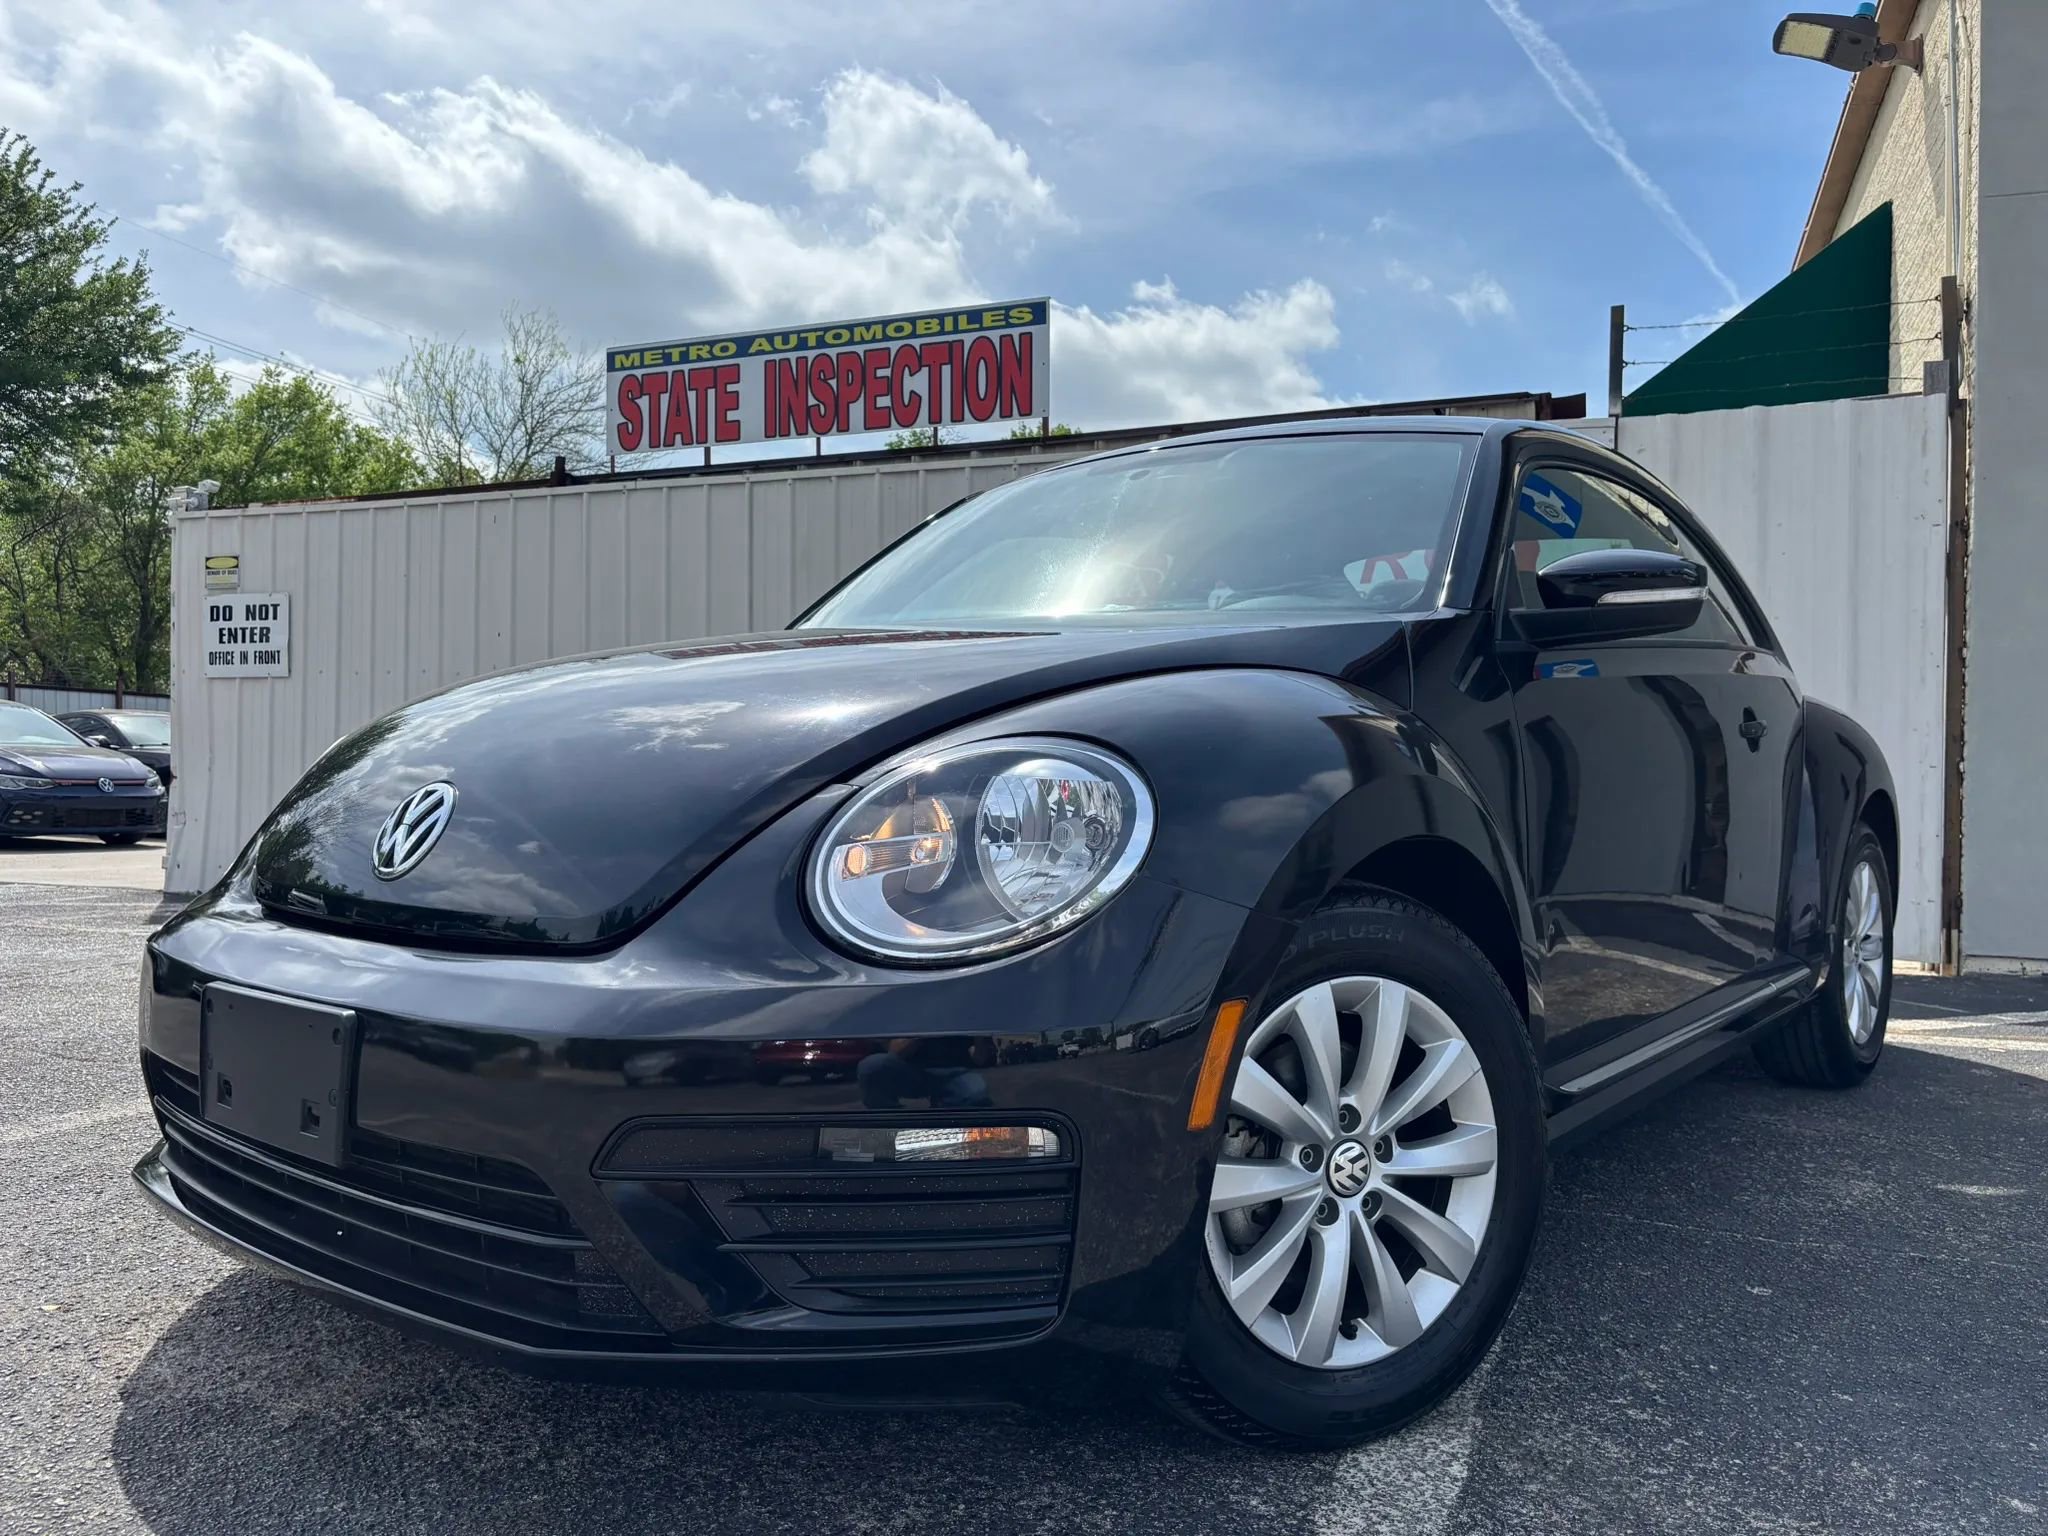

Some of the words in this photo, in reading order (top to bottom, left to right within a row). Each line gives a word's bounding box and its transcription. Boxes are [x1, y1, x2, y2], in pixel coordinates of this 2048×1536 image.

[614, 342, 737, 369] METRO
[747, 307, 1034, 354] AUTOMOBILES
[617, 363, 741, 452] STATE
[764, 331, 1034, 438] INSPECTION
[210, 605, 233, 622] DO
[245, 603, 280, 621] NOT
[218, 626, 271, 644] ENTER
[208, 651, 235, 665] OFFICE
[239, 650, 249, 665] IN
[253, 649, 281, 665] FRONT
[1307, 924, 1406, 949] PLUSH
